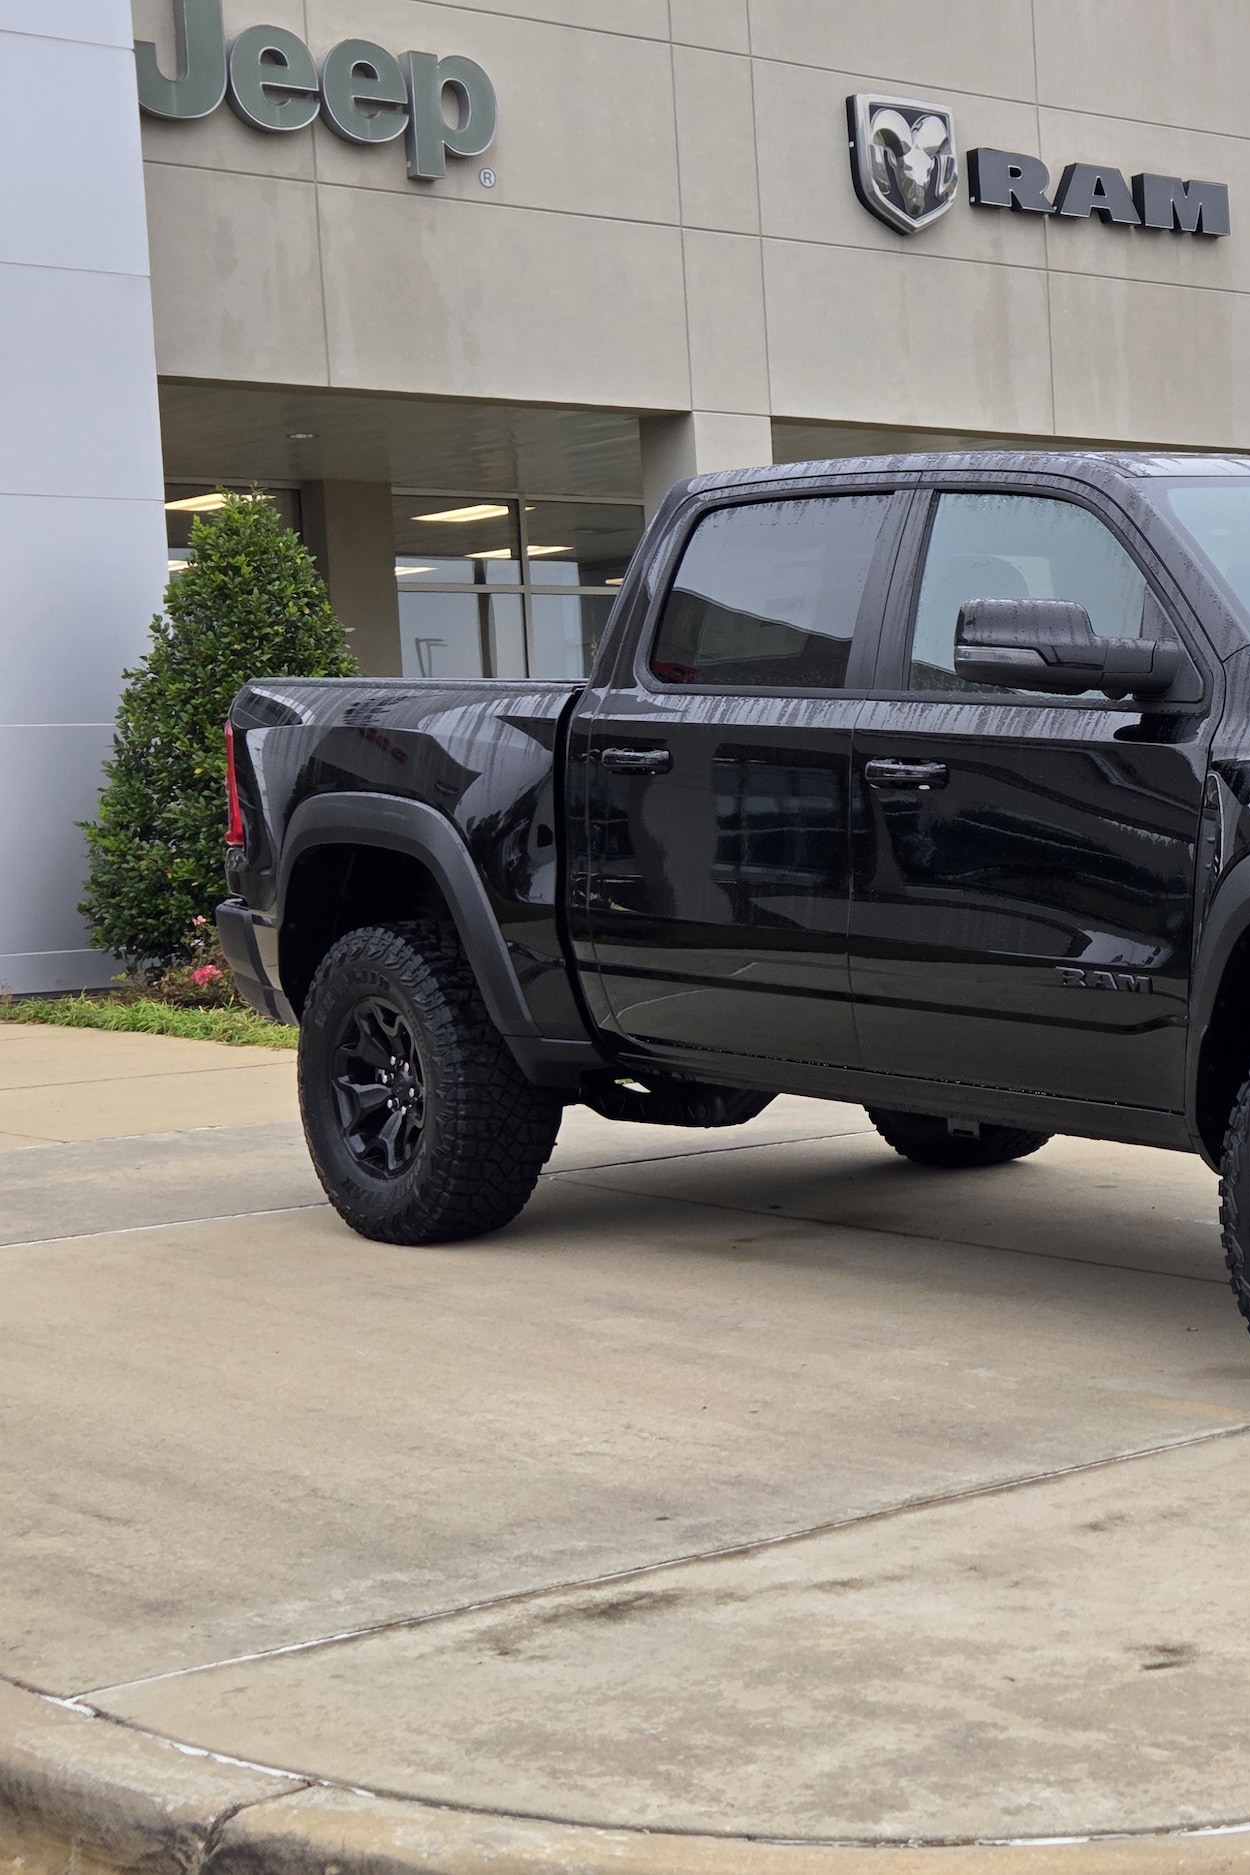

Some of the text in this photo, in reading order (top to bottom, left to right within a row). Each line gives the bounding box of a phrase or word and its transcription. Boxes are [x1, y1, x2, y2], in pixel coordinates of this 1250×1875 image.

[134, 0, 498, 180] Jeep
[966, 147, 1231, 238] RAM
[1053, 965, 1153, 994] RAM
